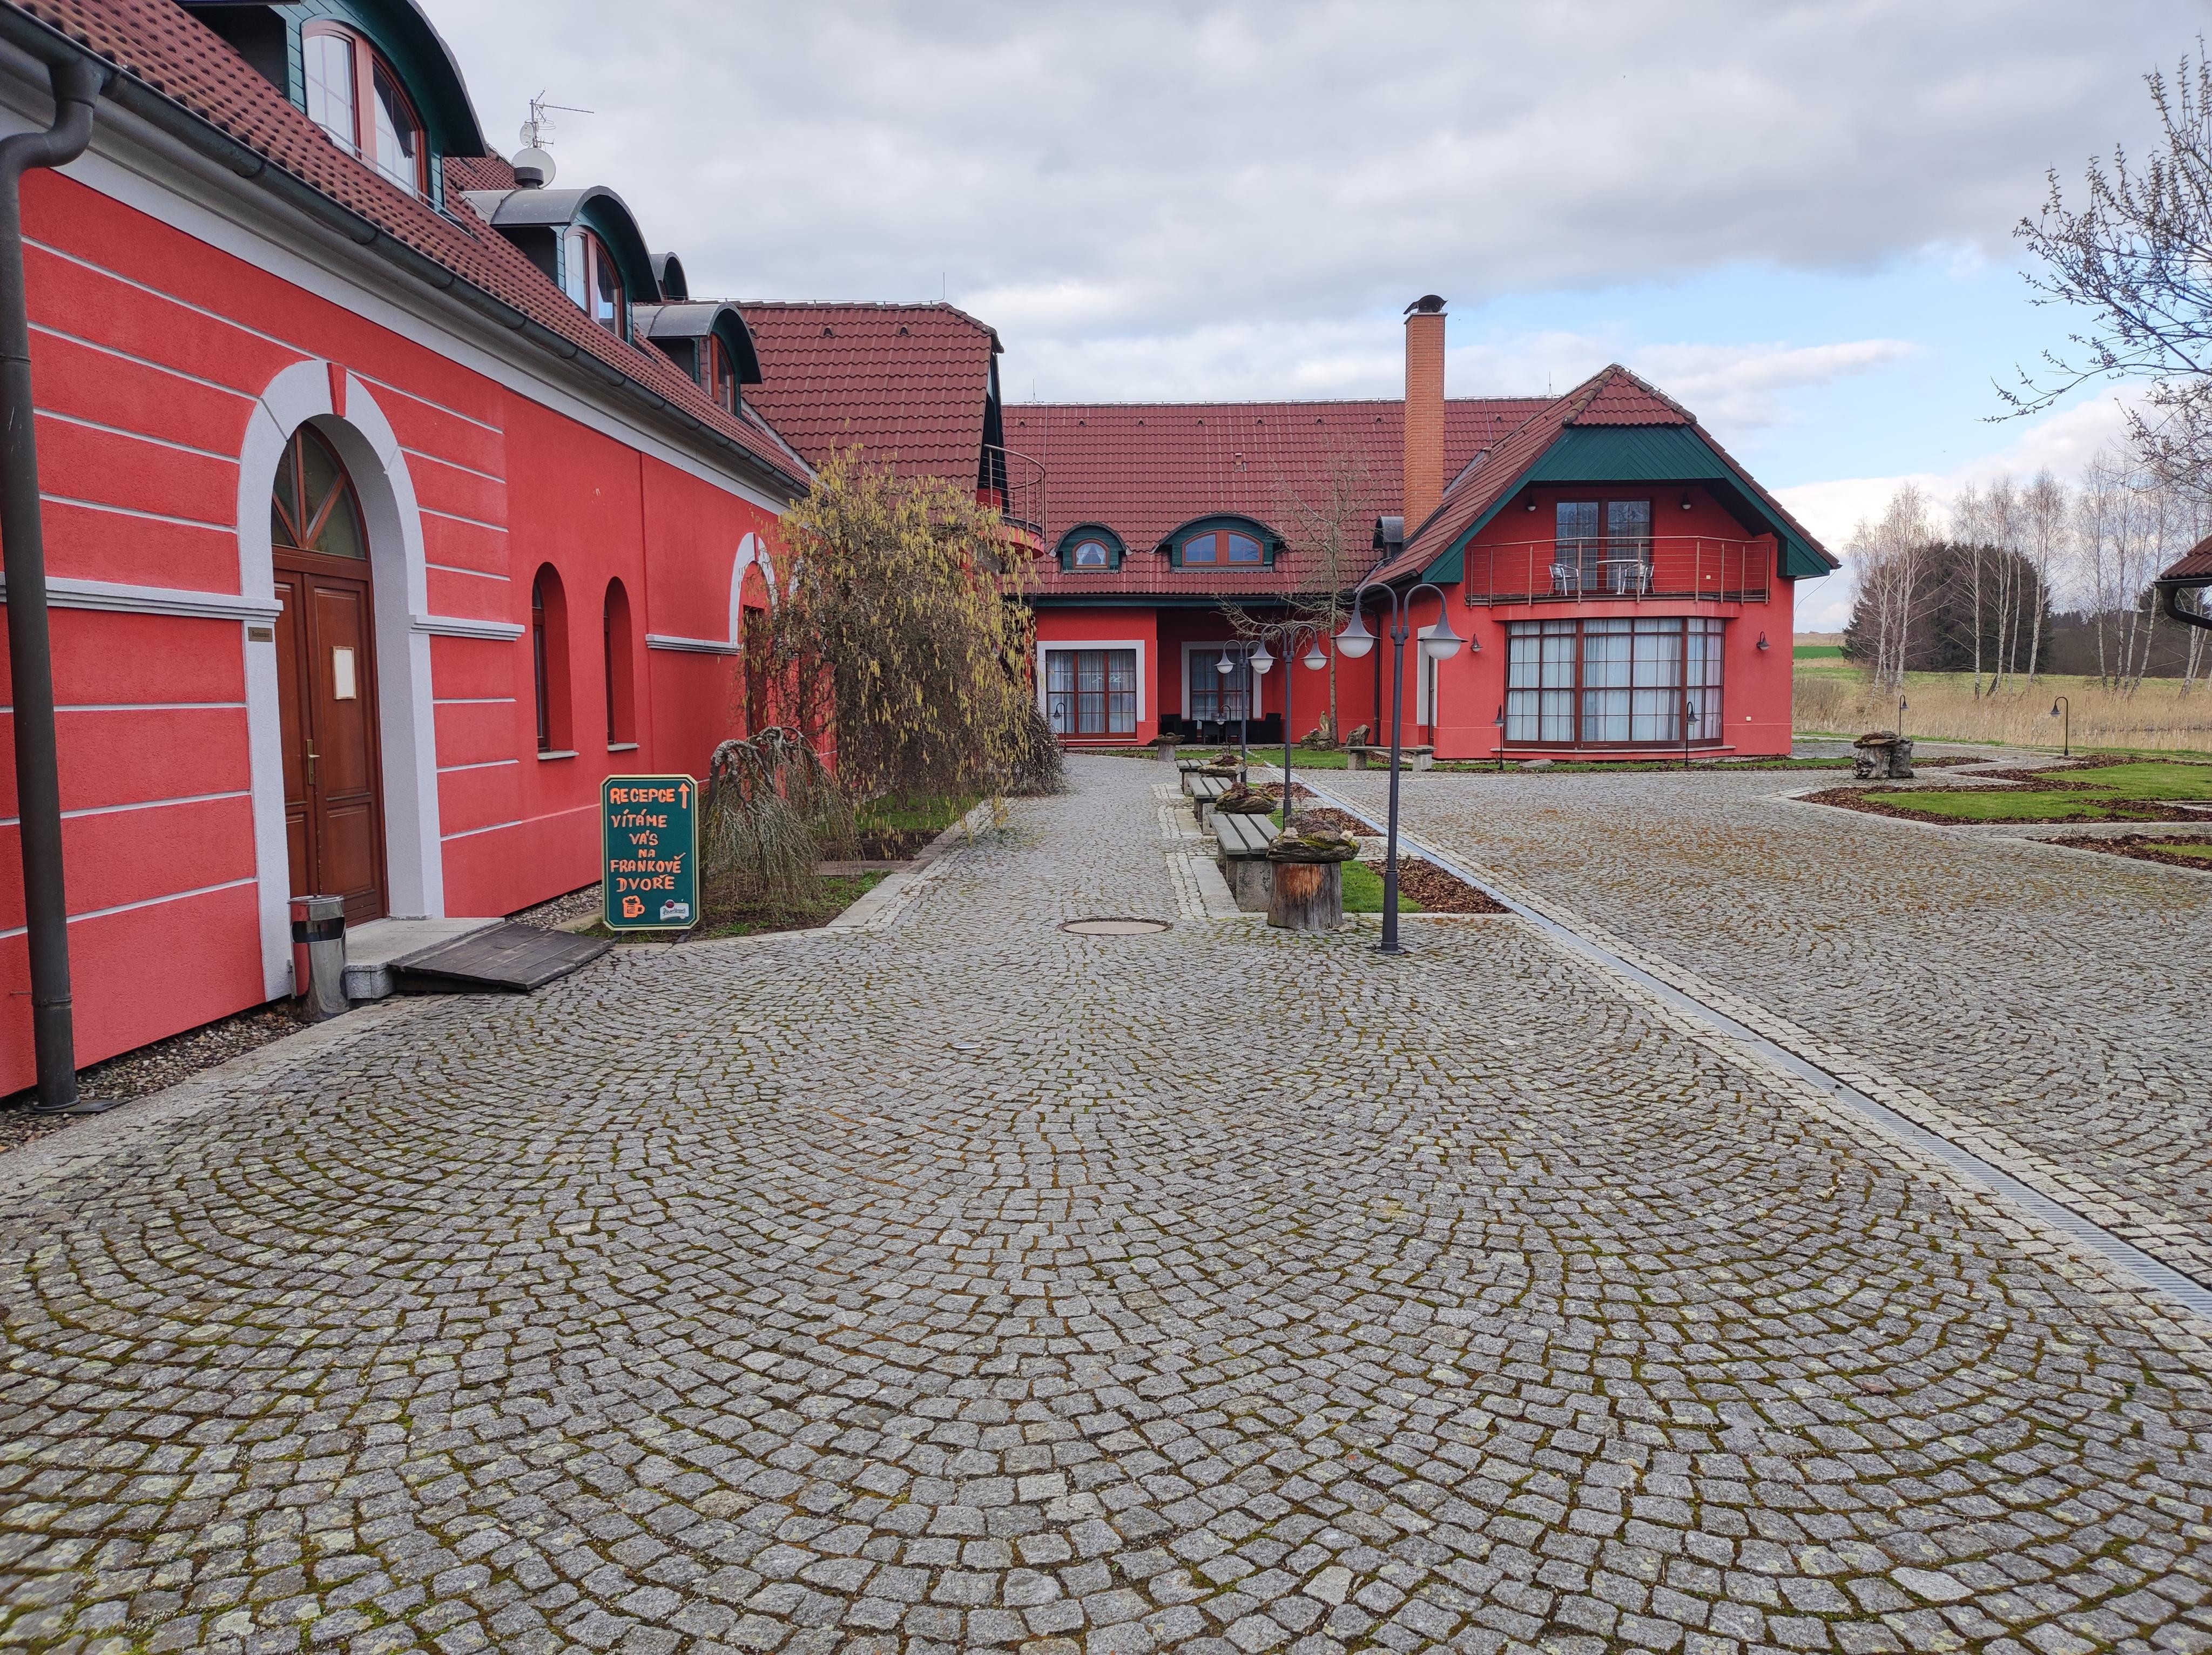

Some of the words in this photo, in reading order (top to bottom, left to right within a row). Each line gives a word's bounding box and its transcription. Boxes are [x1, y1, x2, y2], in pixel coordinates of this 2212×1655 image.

[610, 788, 676, 805] RECEPCE
[611, 809, 668, 828] VÍTÁME
[629, 830, 659, 846] VÁS
[638, 849, 656, 858] NA
[610, 852, 686, 873] FRANKOVĚ
[616, 874, 675, 892] DVOŘE
